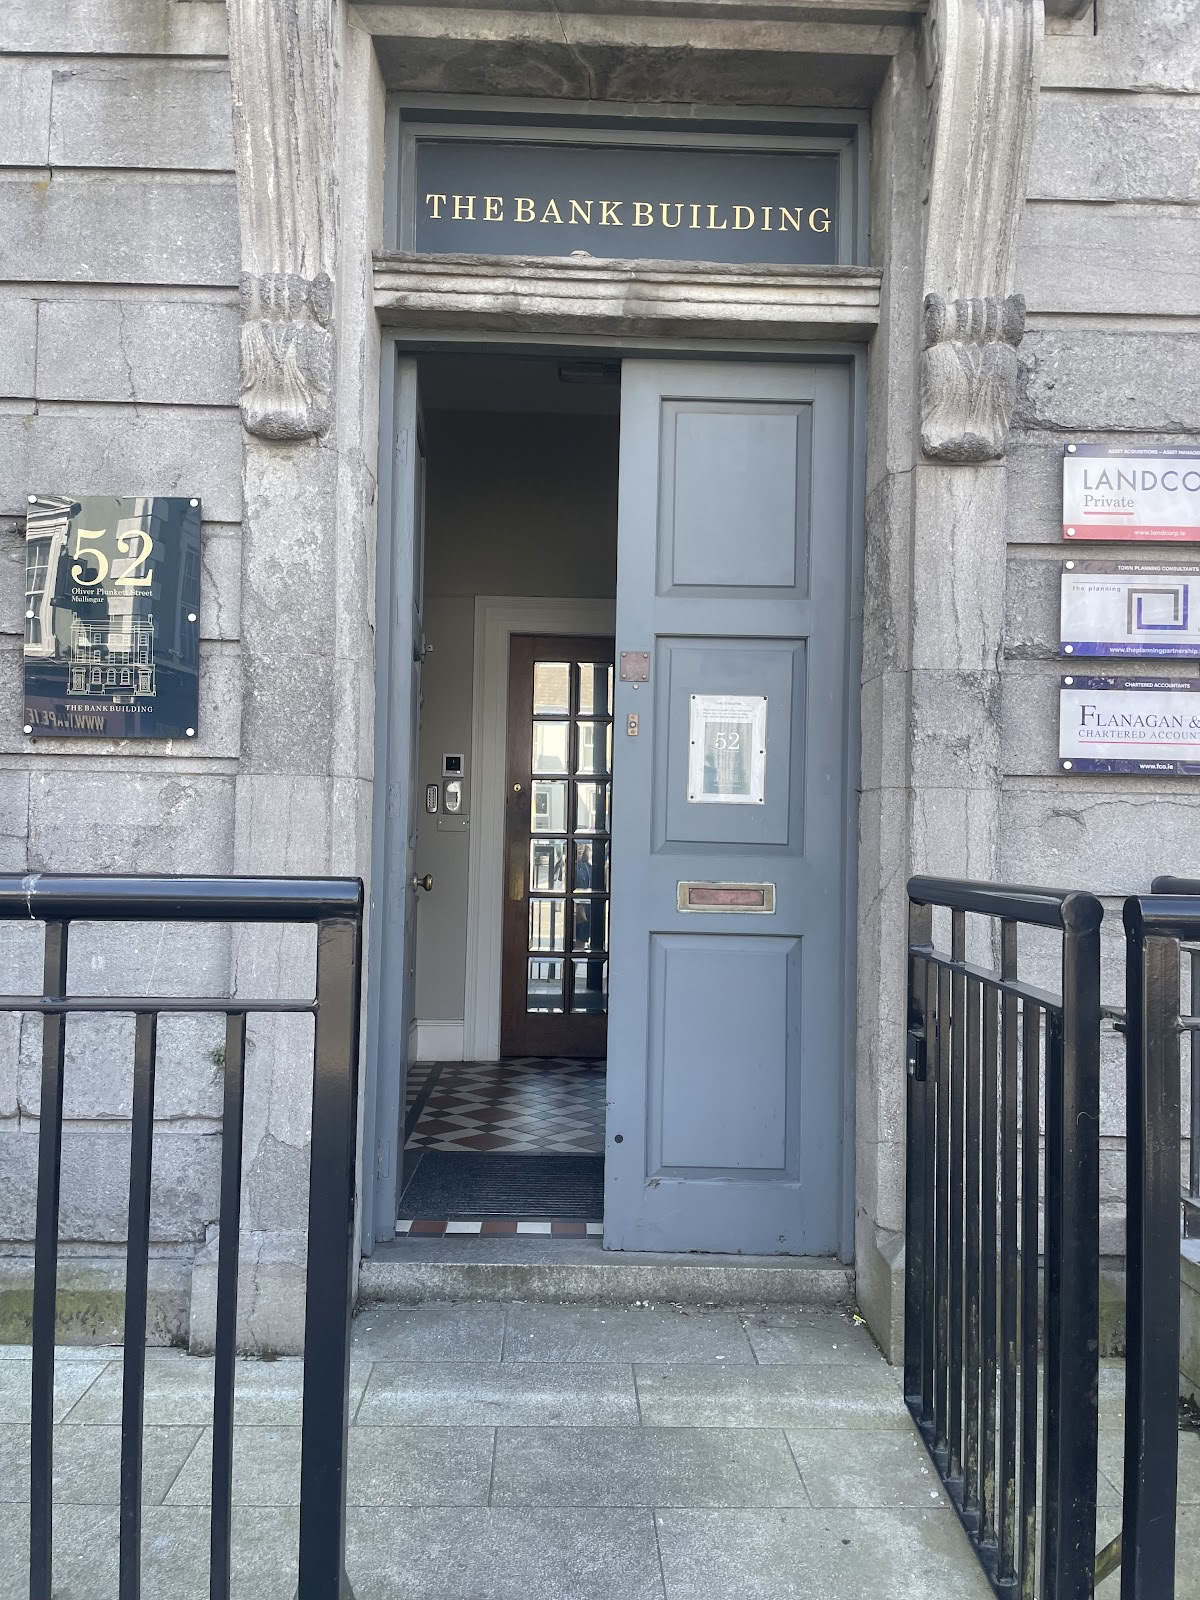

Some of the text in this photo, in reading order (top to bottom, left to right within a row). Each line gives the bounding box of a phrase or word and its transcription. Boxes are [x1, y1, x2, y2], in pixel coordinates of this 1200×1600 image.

[425, 193, 832, 233] THE BANK BUILDING
[1083, 468, 1200, 492] LANDCO
[1083, 494, 1135, 508] Private
[1133, 529, 1186, 537] www.landcorp.ie
[71, 528, 154, 586] 52
[71, 587, 153, 597] Oliver Plunkett Street
[1088, 585, 1121, 593] planning
[71, 595, 104, 604] Mullingar
[65, 704, 153, 713] THE BANK BUILDING
[1079, 704, 1200, 729] FLANAGAN &
[1078, 729, 1146, 739] CHARTERED
[714, 732, 740, 750] 52
